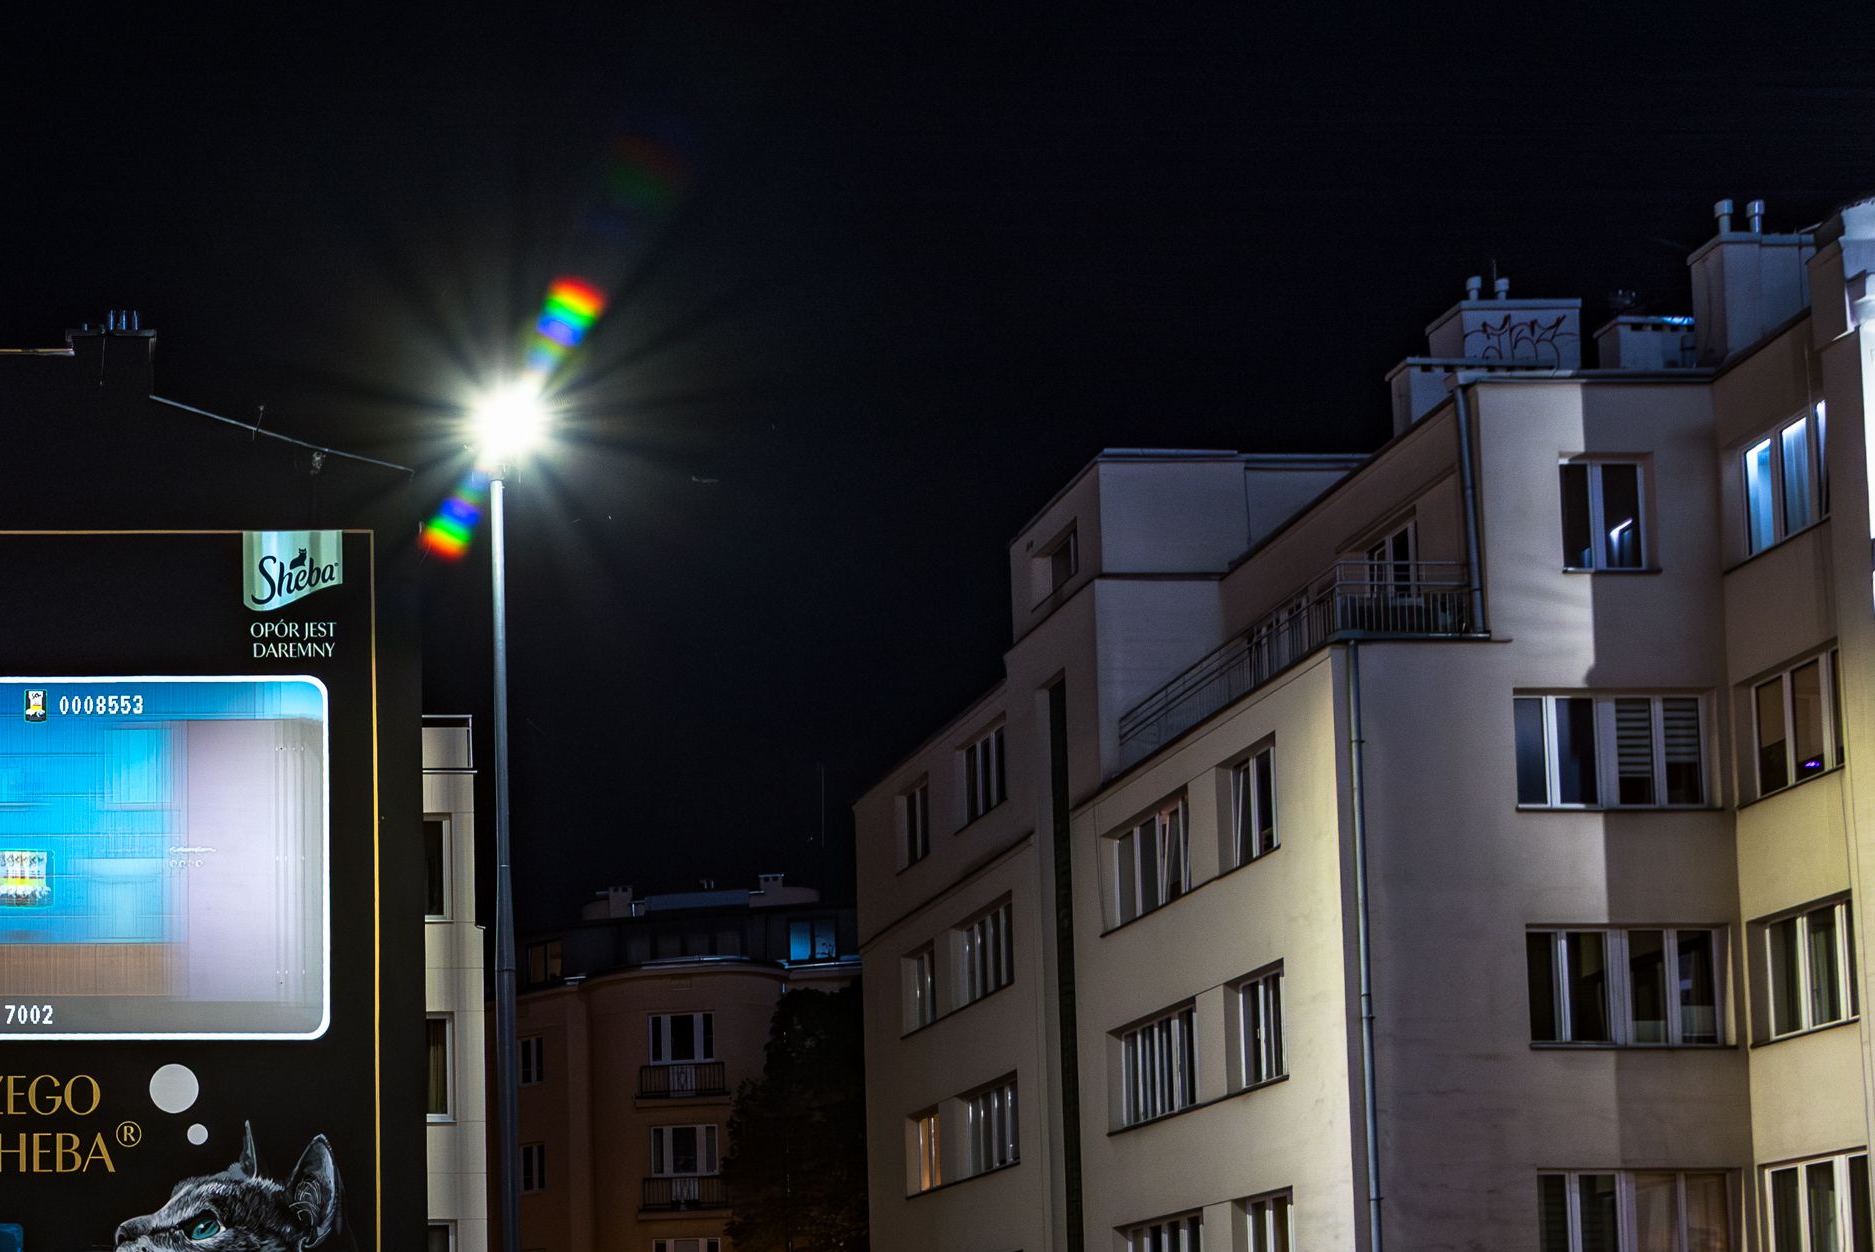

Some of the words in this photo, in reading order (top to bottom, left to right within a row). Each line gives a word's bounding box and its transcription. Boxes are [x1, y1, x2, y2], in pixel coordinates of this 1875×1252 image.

[251, 554, 336, 606] Sheba
[250, 618, 300, 638] OPÓR
[303, 621, 337, 641] JEST
[253, 642, 336, 658] DAREMNY
[59, 694, 144, 715] 0008553
[4, 1004, 54, 1025] 7002
